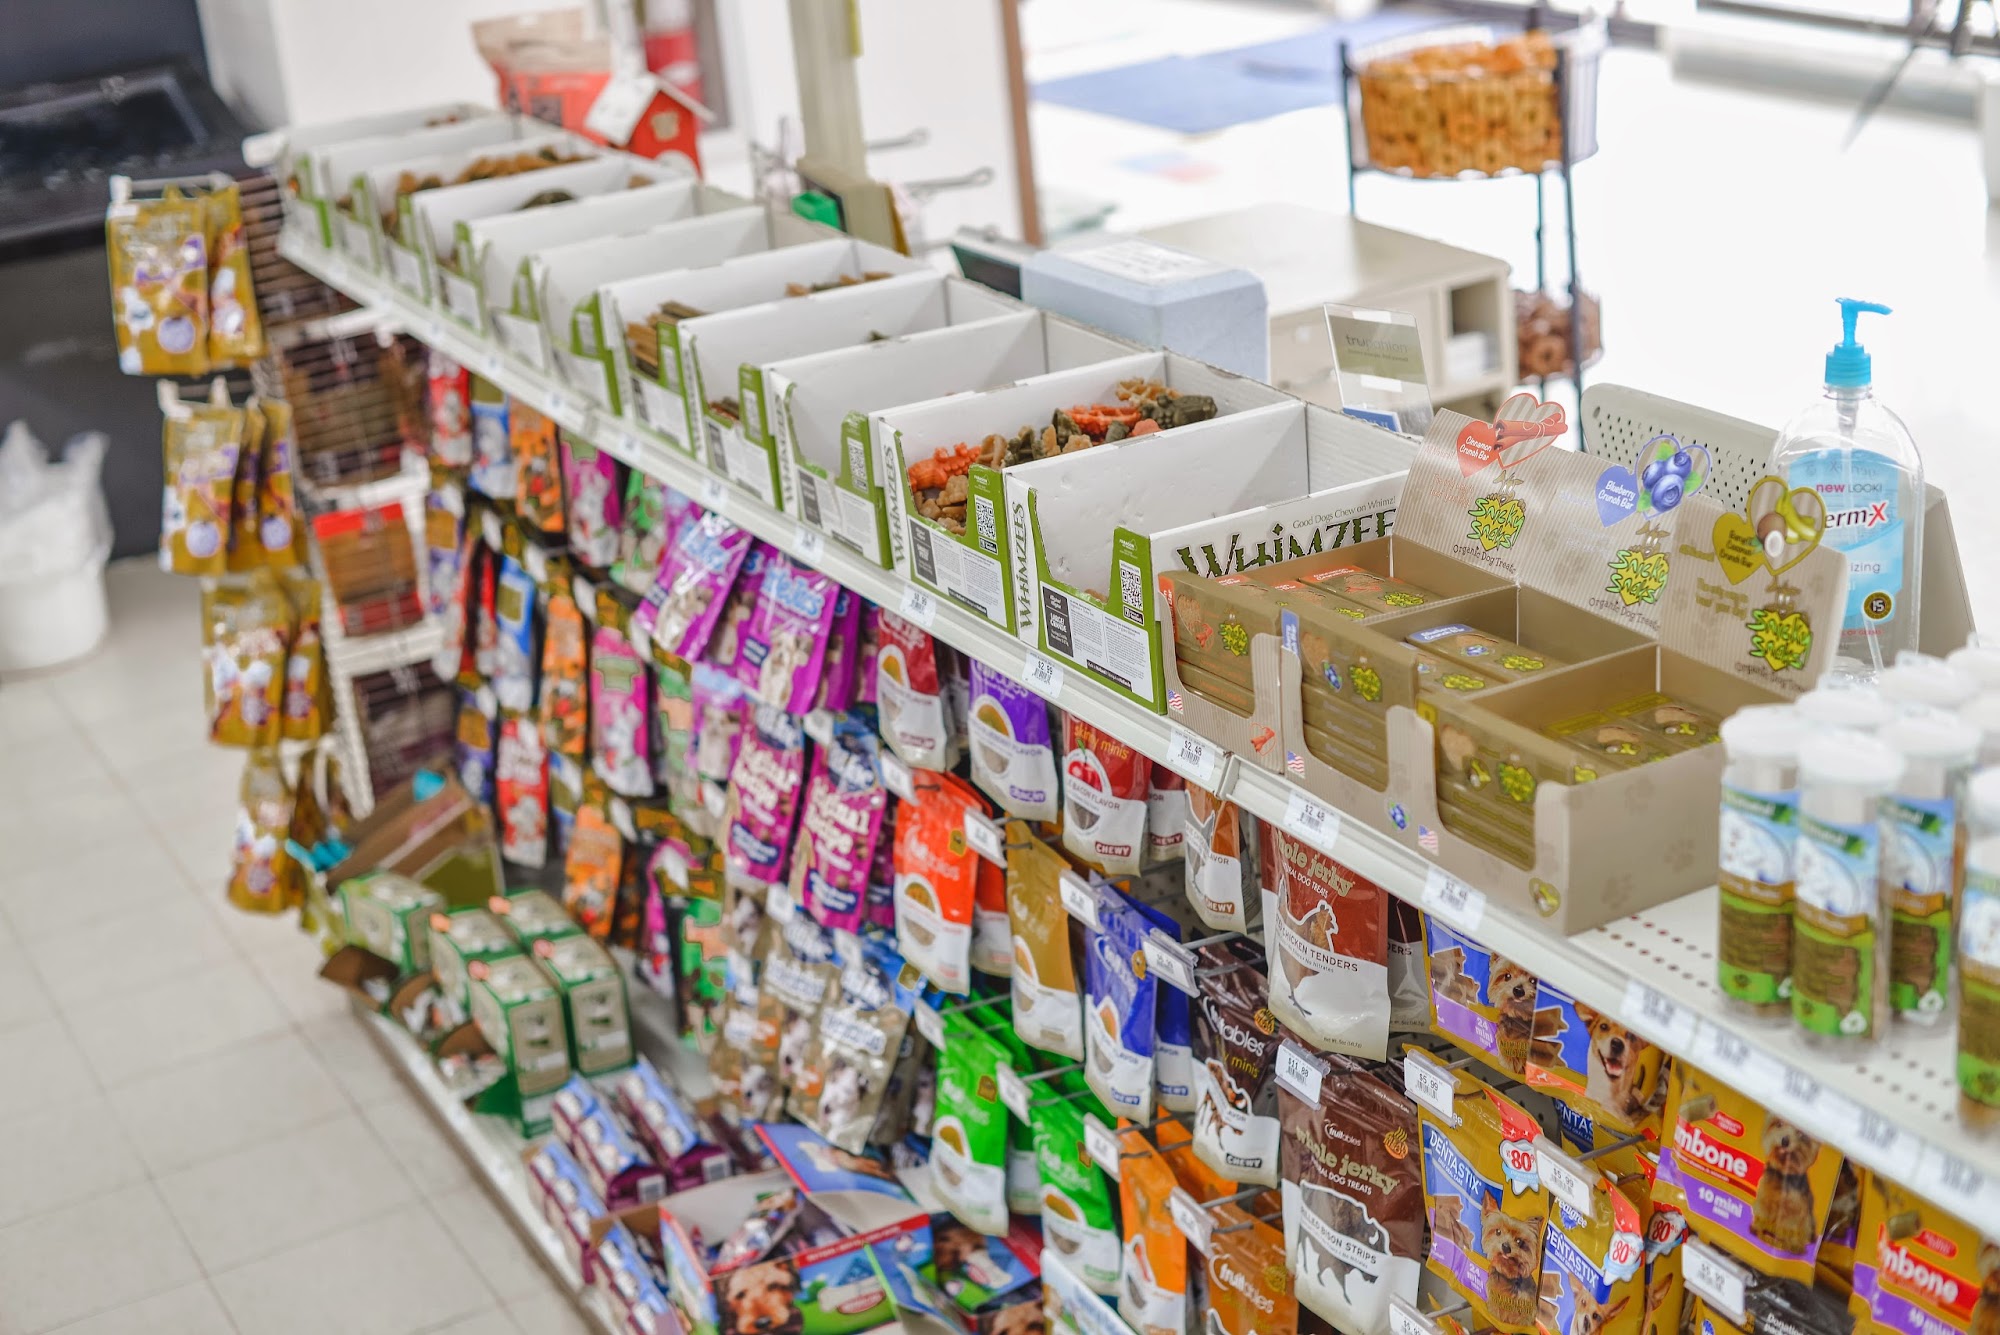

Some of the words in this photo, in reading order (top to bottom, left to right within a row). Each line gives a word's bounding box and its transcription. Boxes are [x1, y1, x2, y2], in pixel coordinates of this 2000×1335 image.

[1459, 443, 1478, 458] Crunch
[1478, 450, 1490, 461] Bar
[1465, 435, 1493, 452] Cinnamon
[1604, 480, 1636, 500] Blueberry
[1816, 482, 1845, 493] new
[1847, 483, 1882, 493] LOOK!
[1598, 490, 1620, 506] Crunch
[1620, 497, 1634, 510] Bar
[1292, 517, 1314, 530] Good
[1314, 511, 1334, 525] Dogs
[1334, 506, 1355, 519] Chew
[1356, 503, 1367, 513] on
[1824, 502, 1889, 528] erm-X
[1177, 508, 1397, 579] WHIMZEE
[1012, 501, 1033, 629] WHIMZEES
[1452, 544, 1481, 559] Organic
[1481, 551, 1495, 567] Dog
[1589, 597, 1620, 613] Organic
[1621, 606, 1636, 622] Dog
[1872, 600, 1885, 612] 15
[1100, 739, 1130, 761] minis
[1090, 792, 1121, 811] FLAVOR
[1096, 843, 1129, 857] CHEWY
[1297, 872, 1311, 887] DOG
[1311, 881, 1329, 899] TREATS
[1307, 852, 1354, 898] jerky
[1282, 926, 1308, 955] CHICKEN
[1310, 949, 1359, 972] TENDERS
[1477, 1016, 1489, 1031] 24
[1475, 1027, 1493, 1044] mini
[1231, 1055, 1260, 1079] minis
[1419, 1073, 1439, 1092] $5.99
[1329, 1125, 1361, 1147] fruitables
[1227, 1155, 1261, 1168] CHEWY
[1430, 1130, 1481, 1195] DENTASTIX
[1328, 1172, 1345, 1186] DOG
[1347, 1179, 1372, 1196] TREATS
[1338, 1153, 1398, 1196] jerky
[1553, 1167, 1574, 1188] $5.99
[1698, 1186, 1715, 1204] 10
[1713, 1195, 1743, 1218] mini
[1320, 1227, 1343, 1249] BISON
[1345, 1241, 1377, 1264] STRIPS
[1467, 1271, 1485, 1289] mini
[1469, 1263, 1480, 1277] 24
